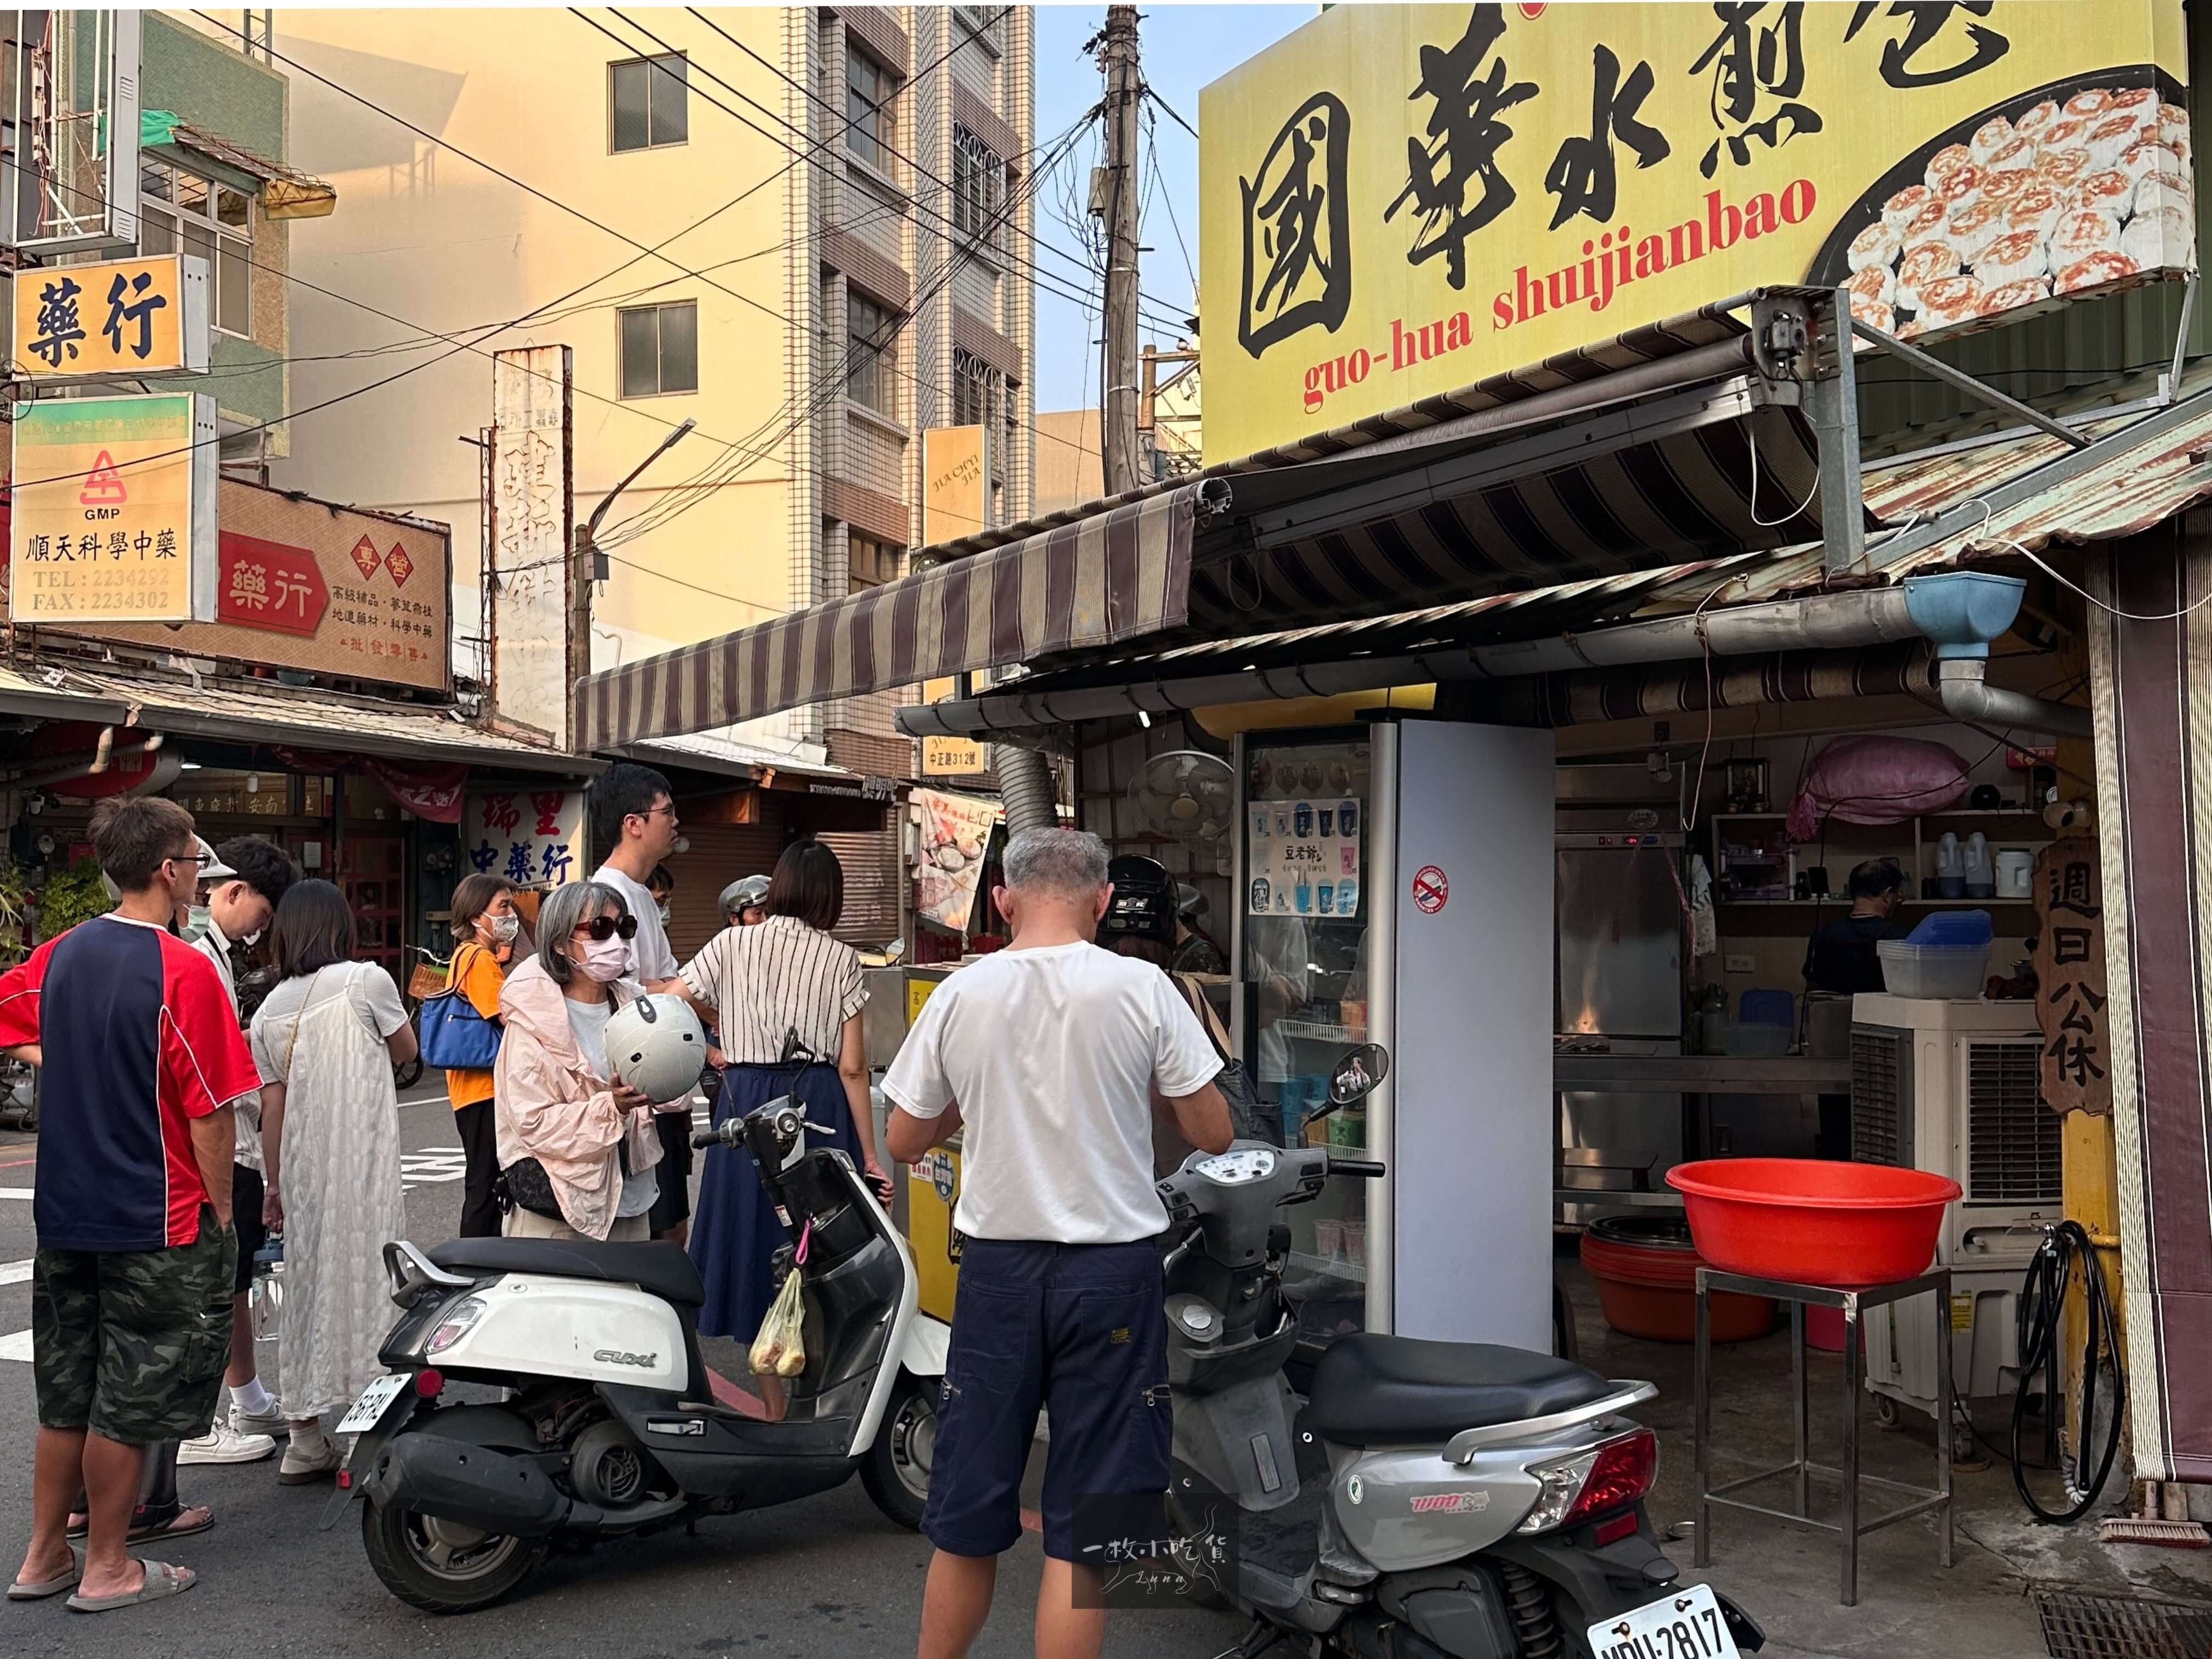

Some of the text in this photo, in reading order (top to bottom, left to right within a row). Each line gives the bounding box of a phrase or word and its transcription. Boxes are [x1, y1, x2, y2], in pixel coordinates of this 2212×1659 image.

[28, 272, 167, 368] 藥行
[1304, 178, 1816, 414] guo-hua shuijianbao
[84, 509, 120, 520] GMP
[25, 528, 177, 561] 順天科學中藥
[91, 591, 168, 610] 2234302
[229, 560, 313, 618] 藥行
[470, 839, 573, 886] 中藥行
[2047, 861, 2106, 1087] 週日公休
[1601, 1607, 1722, 1659] -2817
